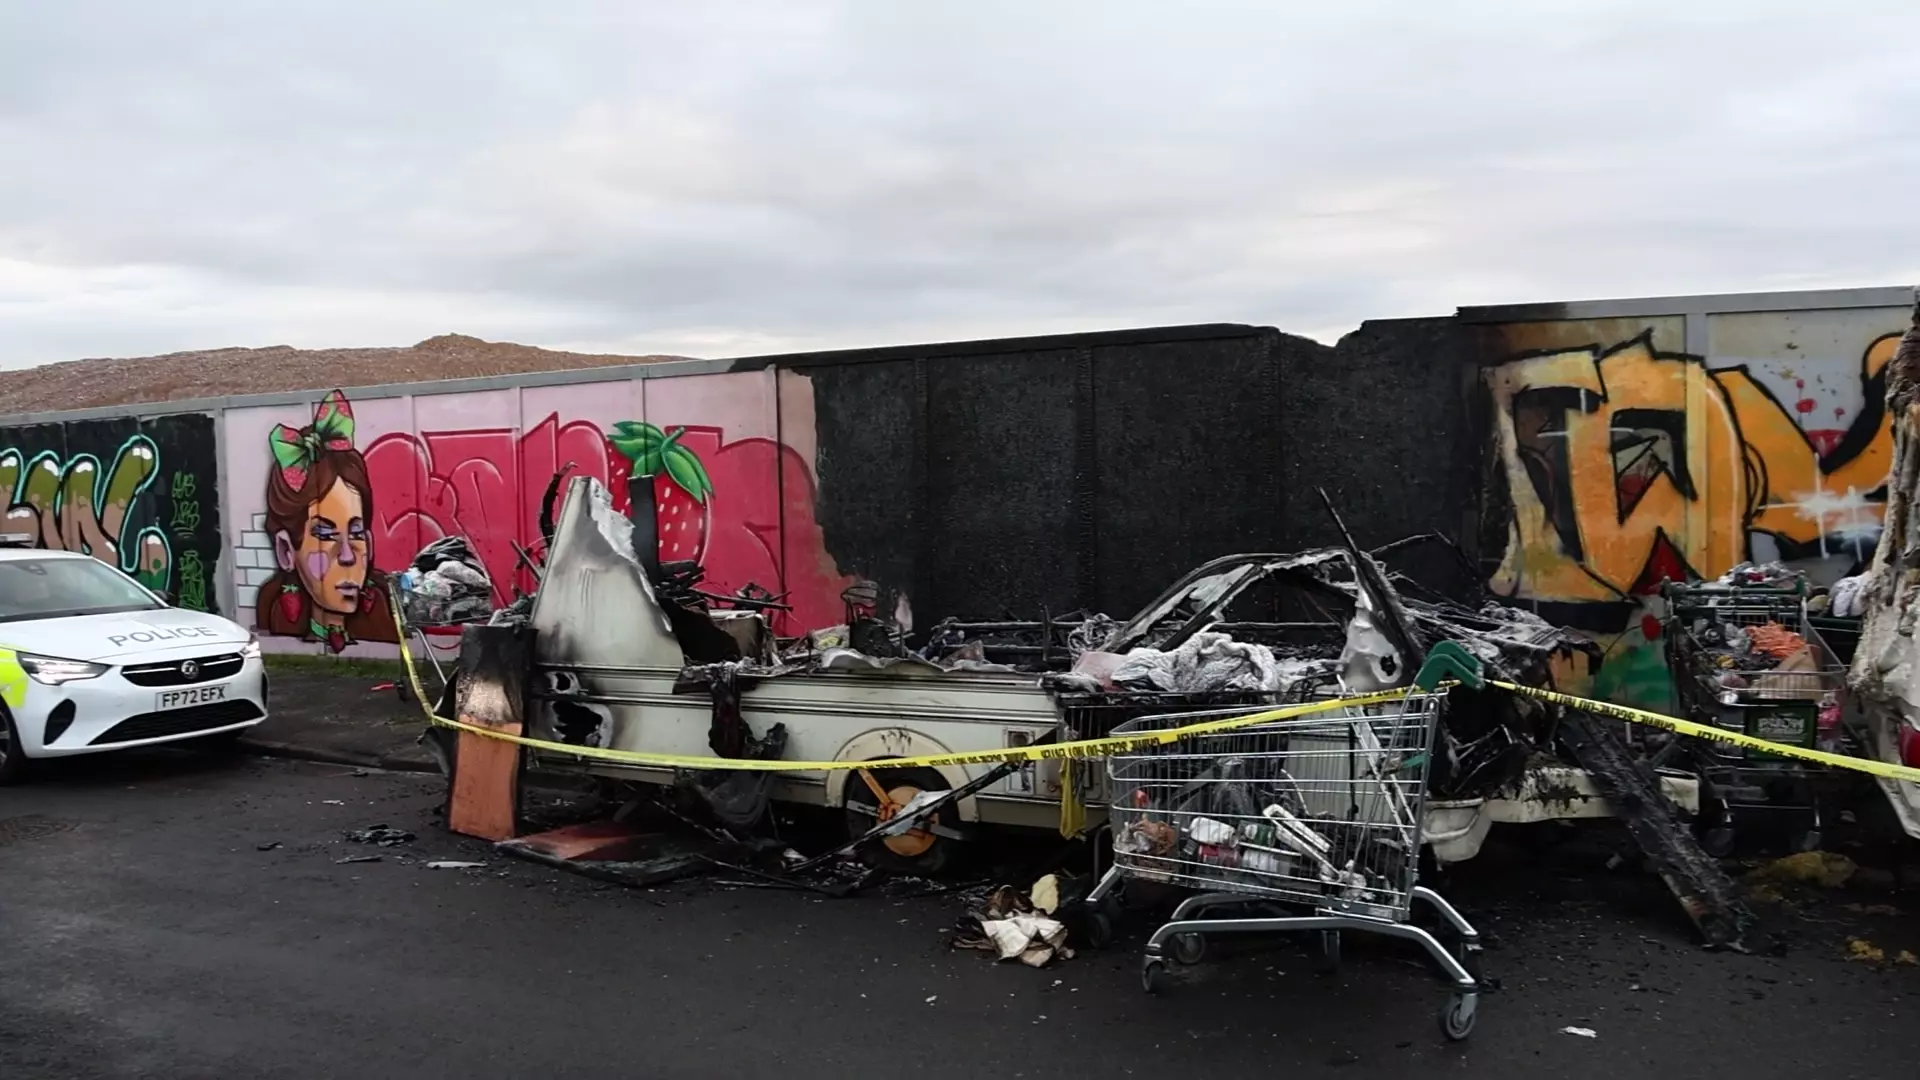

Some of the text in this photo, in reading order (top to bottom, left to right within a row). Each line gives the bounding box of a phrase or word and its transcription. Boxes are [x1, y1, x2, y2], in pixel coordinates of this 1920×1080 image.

[107, 626, 218, 647] POLICE
[162, 686, 226, 708] FP72 EFX
